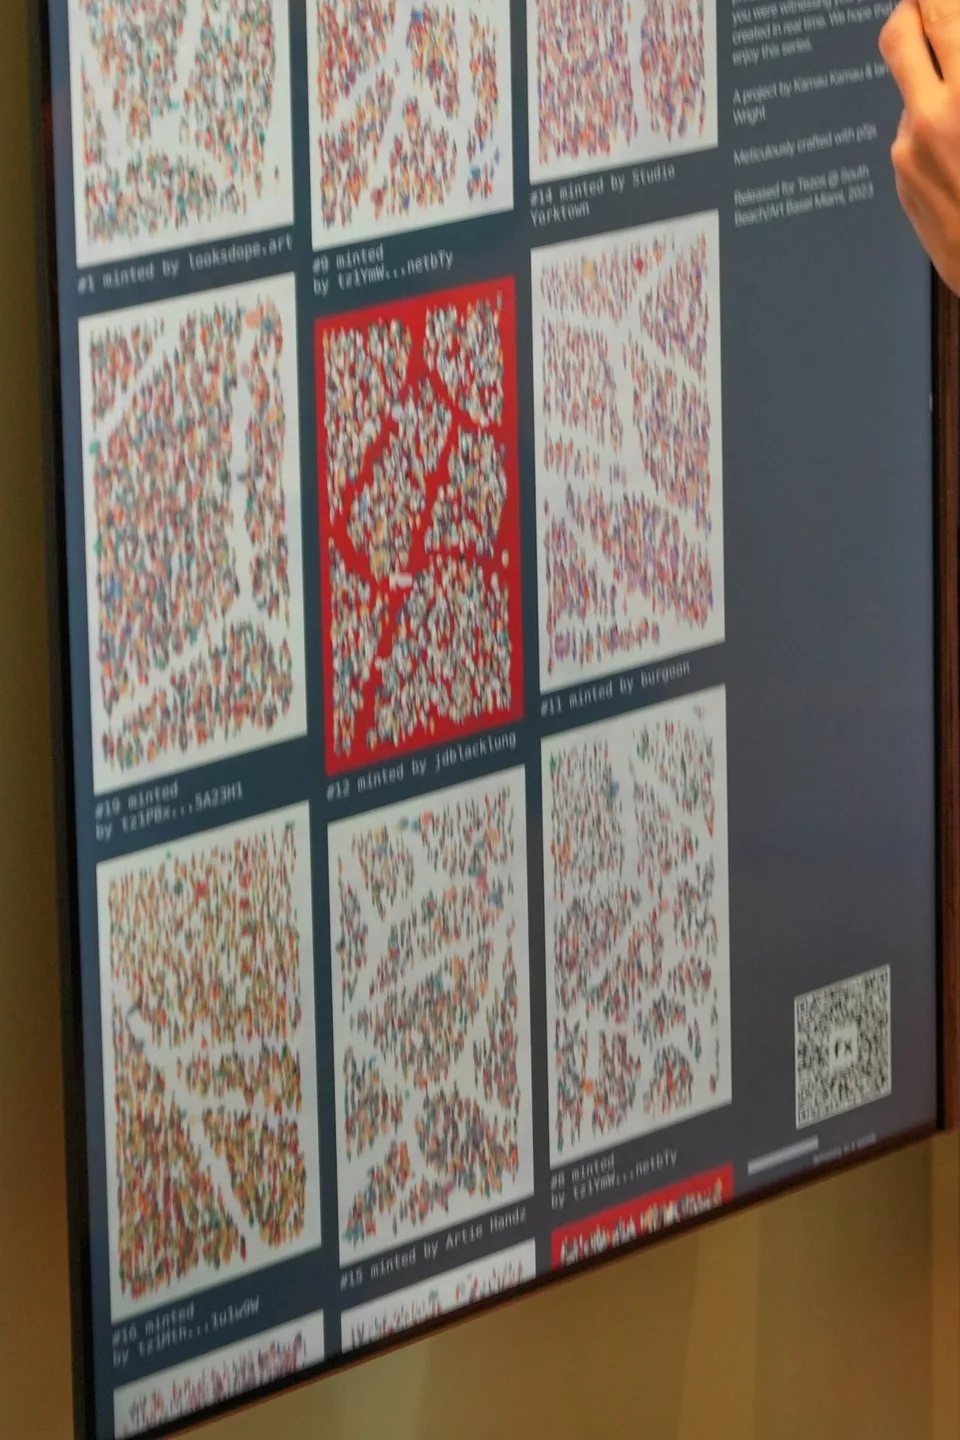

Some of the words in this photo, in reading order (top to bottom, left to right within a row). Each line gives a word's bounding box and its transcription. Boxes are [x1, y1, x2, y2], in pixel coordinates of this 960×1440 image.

[733, 89, 741, 104] A
[778, 80, 791, 99] by
[733, 105, 766, 127] Wright
[559, 175, 603, 202] minted
[610, 170, 624, 194] by
[632, 159, 675, 187] Studio
[530, 197, 589, 228] Yorktown
[102, 261, 155, 290] minted
[162, 256, 179, 280] by
[189, 233, 293, 271] looksdope.art
[335, 242, 384, 270] minted
[313, 274, 328, 298] by
[569, 679, 612, 709] minted
[620, 673, 633, 696] by
[357, 762, 403, 792] minted
[412, 755, 426, 778] by
[127, 780, 177, 810] minted
[96, 818, 111, 843] by
[571, 1152, 614, 1183] minted
[551, 1187, 564, 1212] by
[370, 1245, 415, 1279] minted
[423, 1237, 438, 1262] by
[446, 1221, 482, 1251] Artie
[145, 1304, 194, 1336] minted
[113, 1345, 128, 1369] by
